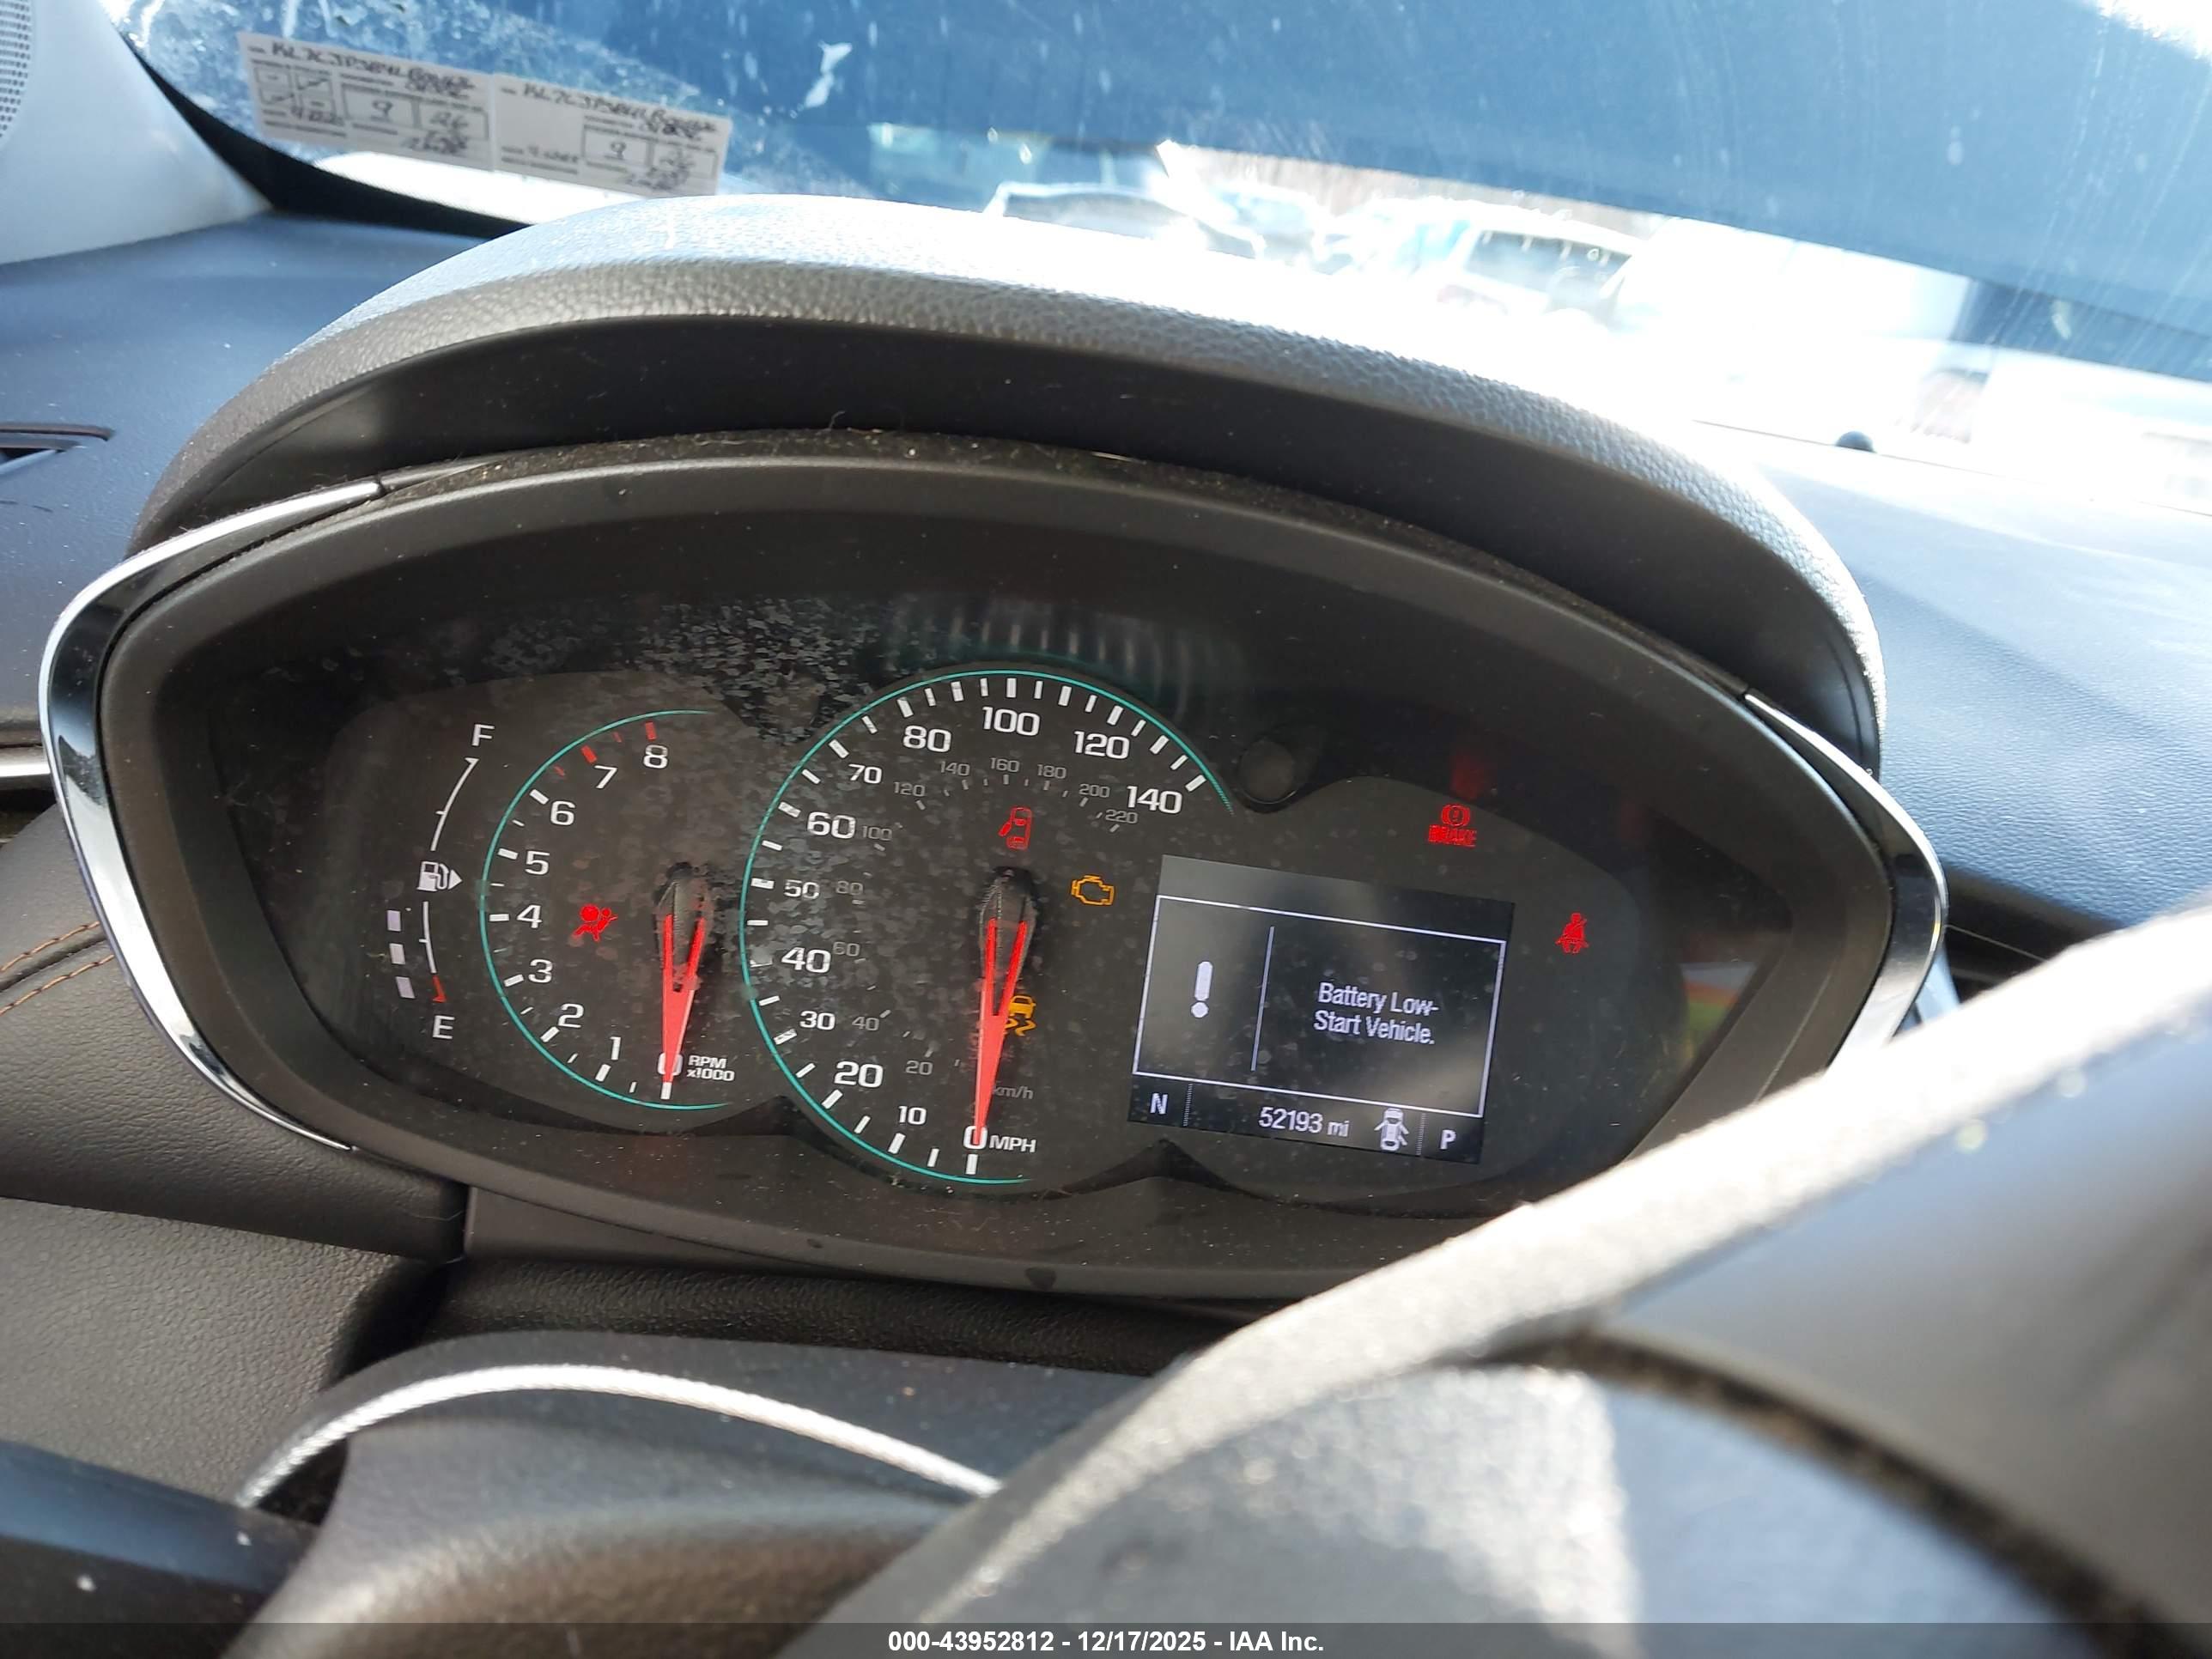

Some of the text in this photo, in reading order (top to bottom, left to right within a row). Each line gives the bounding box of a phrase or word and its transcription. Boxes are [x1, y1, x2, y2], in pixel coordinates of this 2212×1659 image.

[982, 706, 1041, 736] 100
[471, 724, 495, 747] F
[902, 725, 952, 752] 80
[1073, 731, 1130, 759] 120
[643, 744, 669, 769] 8
[940, 760, 970, 776] 140
[990, 757, 1021, 773] 160
[594, 765, 618, 789] 7
[848, 763, 883, 785] 70
[1036, 763, 1067, 780] 180
[893, 781, 926, 798] 120
[1079, 782, 1110, 799] 200
[1127, 785, 1183, 815] 140
[550, 800, 576, 827] 6
[807, 811, 856, 839] 60
[1104, 808, 1139, 824] 220
[861, 825, 893, 842] 100
[526, 850, 551, 875] 5
[783, 879, 821, 900] 50
[836, 879, 864, 896] 80
[517, 904, 543, 929] 4
[781, 946, 832, 974] 40
[833, 941, 860, 957] 60
[528, 958, 554, 984] 3
[1316, 981, 1440, 1018] Battery Low-
[432, 1015, 455, 1039] E
[558, 1003, 585, 1029] 2
[799, 1010, 836, 1030] 30
[851, 1016, 880, 1031] 40
[1314, 1009, 1436, 1045] Start Vehicle.
[609, 1036, 622, 1060] 1
[688, 1054, 727, 1069] RPM
[905, 1060, 934, 1076] 20
[834, 1060, 884, 1088] 20
[1150, 1092, 1169, 1115] N
[899, 1105, 927, 1126] 10
[1258, 1105, 1350, 1138] 52193 mi
[963, 1125, 988, 1150] 0
[988, 1134, 1037, 1153] MPH
[1439, 1129, 1457, 1151] P
